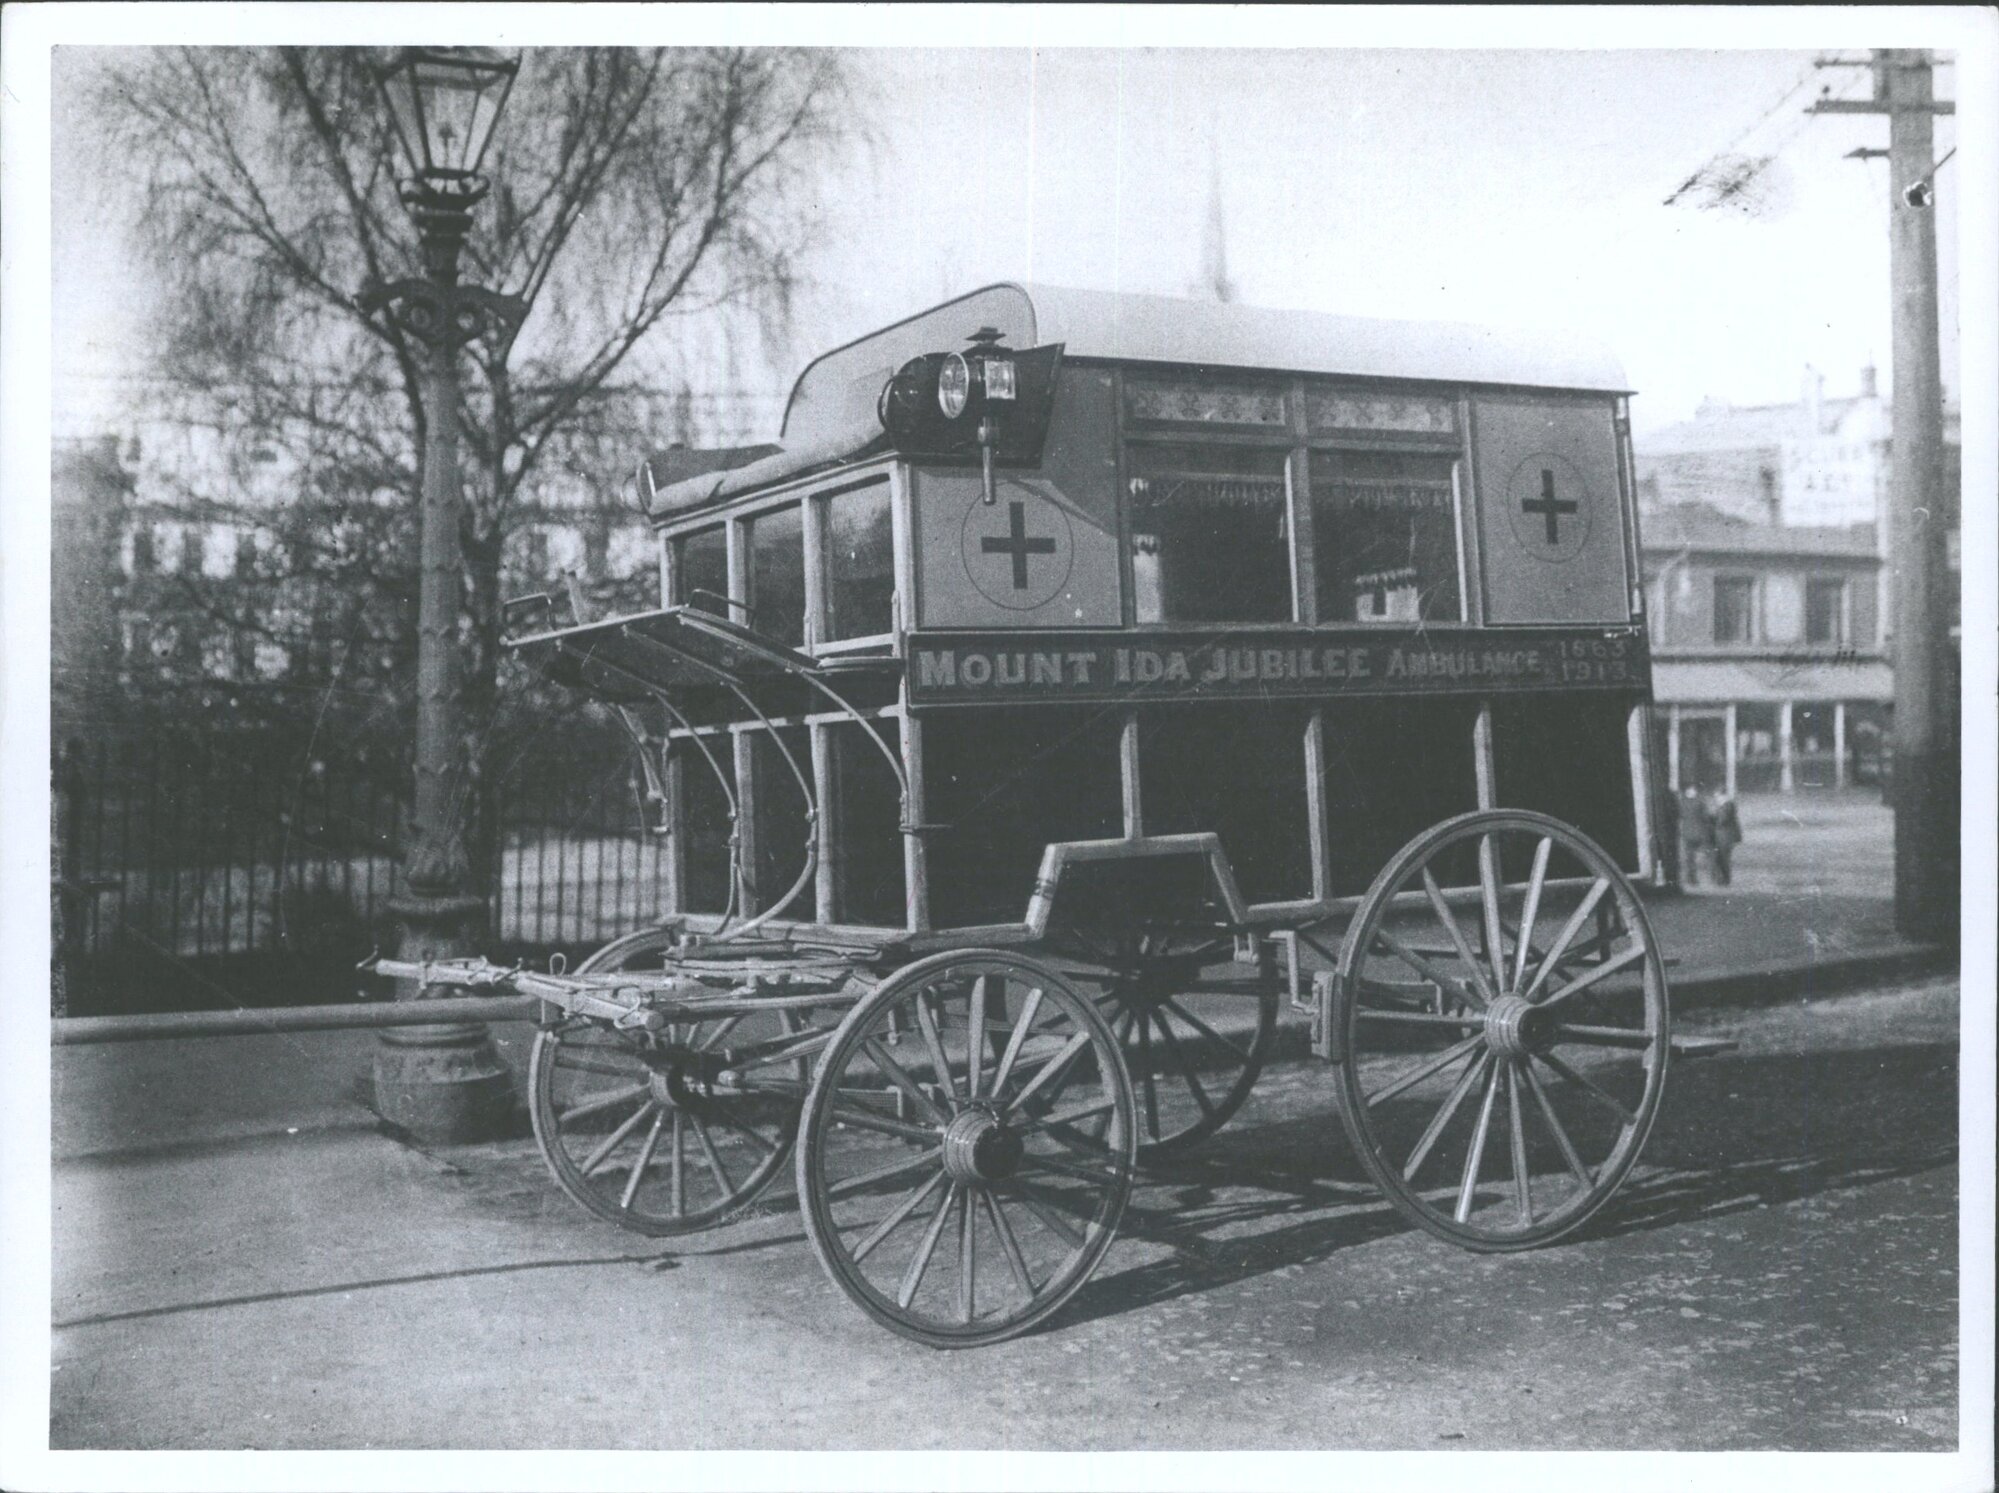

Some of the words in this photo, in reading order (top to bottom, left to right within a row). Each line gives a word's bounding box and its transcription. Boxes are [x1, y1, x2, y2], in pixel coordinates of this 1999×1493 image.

[1558, 638, 1627, 659] 1863
[917, 649, 1097, 687] MOUNT
[1114, 647, 1191, 684] IDA
[1204, 646, 1371, 683] JUBILEE
[1386, 645, 1541, 680] AMBULANCE
[1558, 660, 1628, 683] 1913
